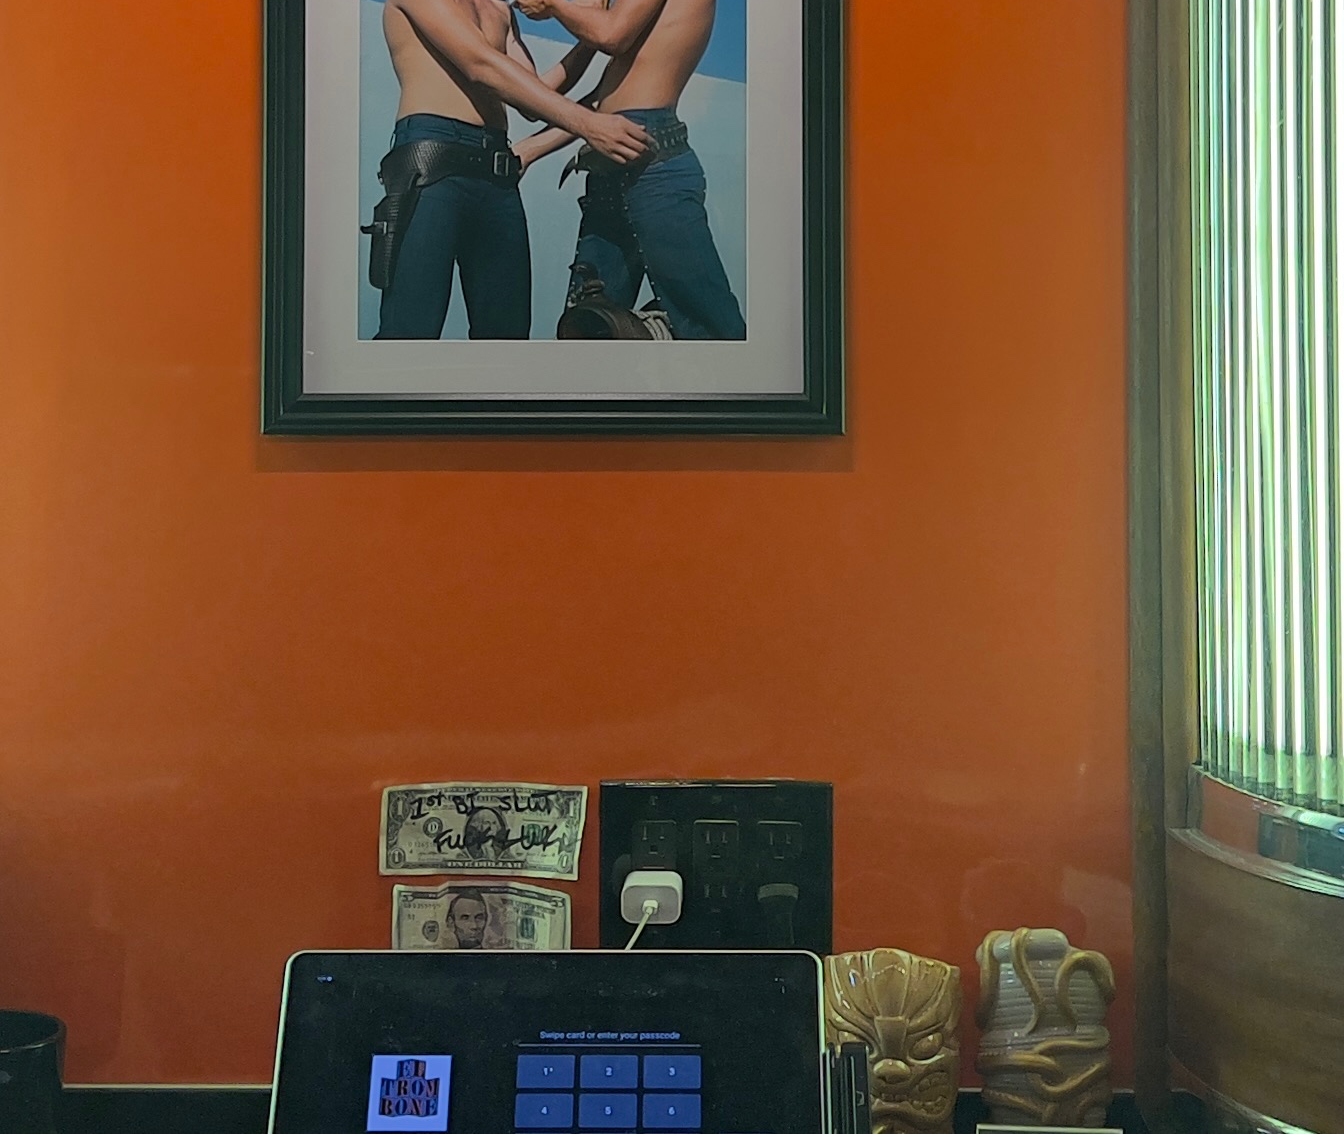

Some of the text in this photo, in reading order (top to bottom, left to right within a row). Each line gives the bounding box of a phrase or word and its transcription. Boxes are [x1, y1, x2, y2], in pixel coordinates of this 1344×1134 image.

[539, 1030, 565, 1040] Swipe
[566, 1030, 585, 1039] card
[597, 1031, 619, 1039] enter
[620, 1032, 638, 1040] your
[639, 1031, 681, 1040] passcode
[606, 1067, 613, 1076] 2
[669, 1067, 676, 1076] 3
[380, 1098, 438, 1117] BONE
[541, 1106, 548, 1115] 4
[605, 1106, 612, 1115] 5
[668, 1106, 675, 1115] 6
